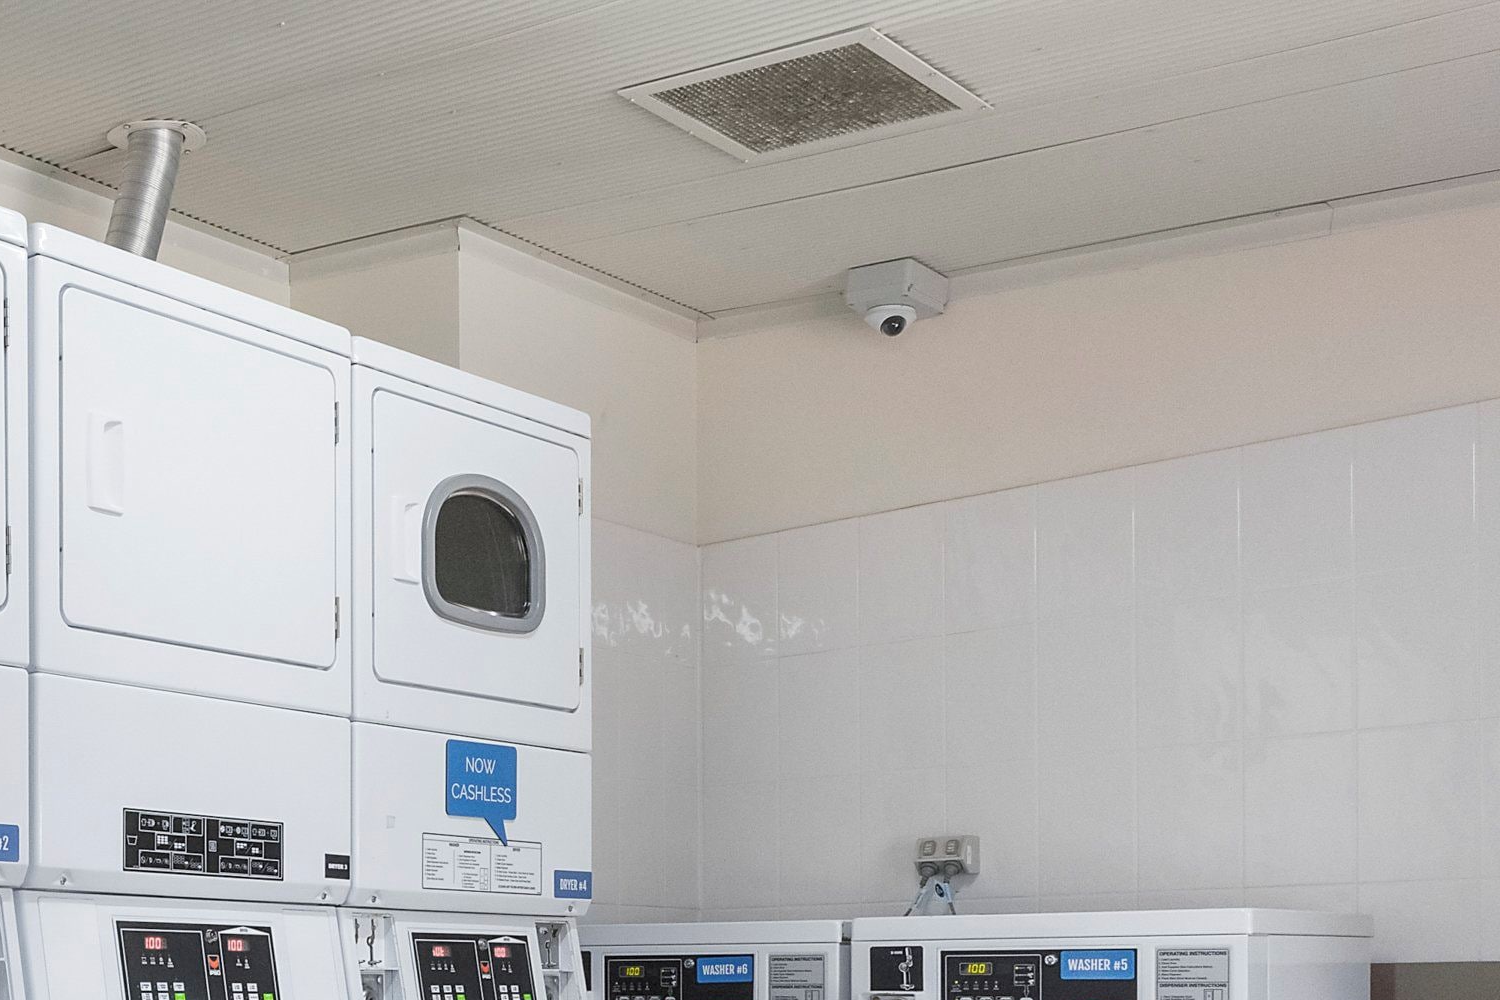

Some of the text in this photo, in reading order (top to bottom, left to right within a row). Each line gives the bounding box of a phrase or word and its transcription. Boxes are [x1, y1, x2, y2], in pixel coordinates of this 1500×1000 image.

[465, 756, 496, 774] NOW
[451, 782, 512, 804] CASHLESS
[560, 879, 587, 891] DRYER #4
[145, 937, 161, 949] 100
[228, 940, 242, 951] 100
[702, 964, 748, 975] WASHER #6
[968, 964, 986, 973] 100
[1068, 958, 1128, 971] WASHER #5
[626, 967, 640, 976] 100
